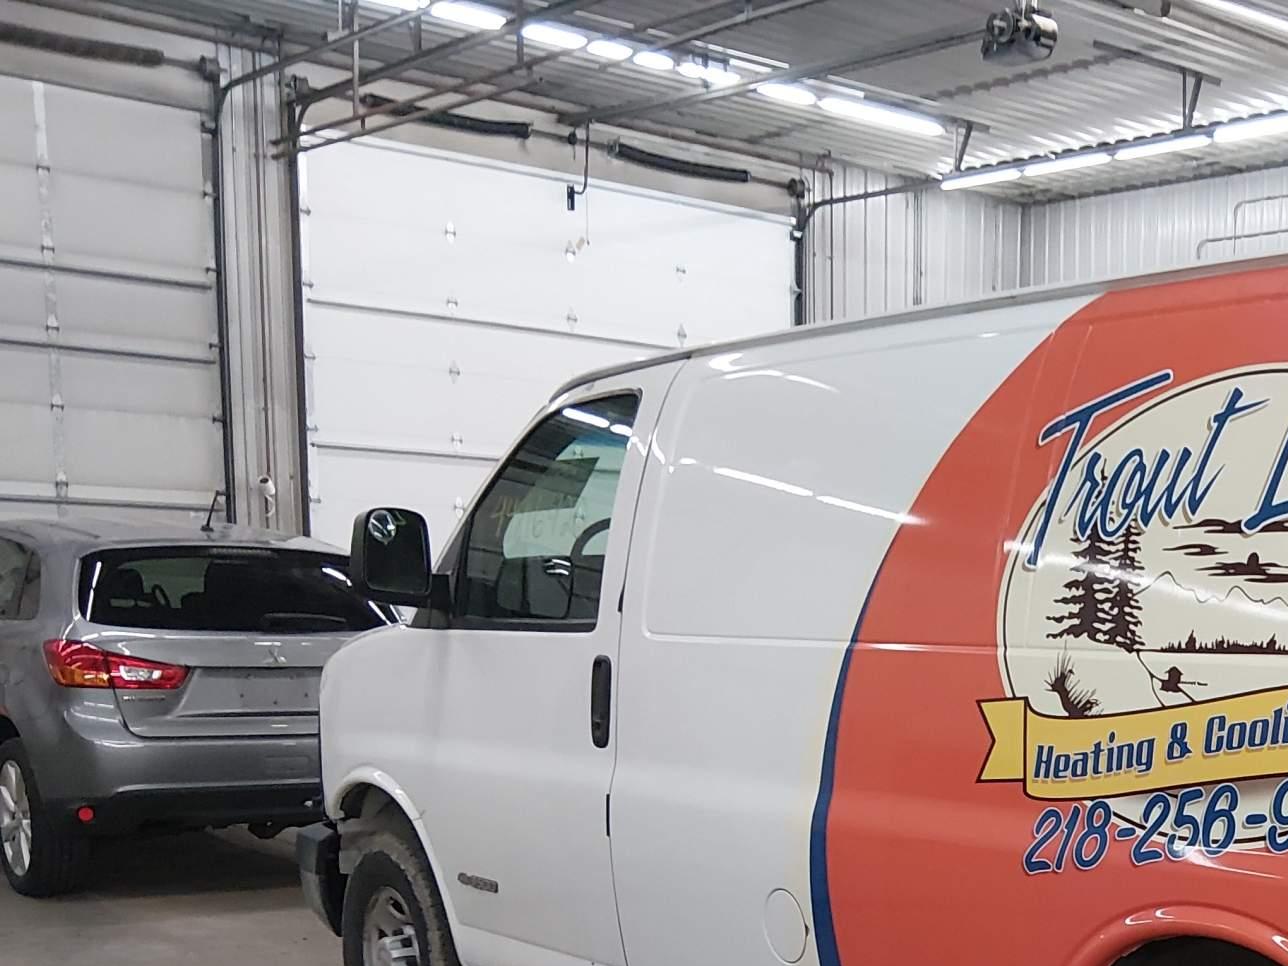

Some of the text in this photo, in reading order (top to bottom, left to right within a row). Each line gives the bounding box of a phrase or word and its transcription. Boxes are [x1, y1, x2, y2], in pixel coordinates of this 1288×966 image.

[1024, 370, 1271, 571] Trout
[1032, 731, 1155, 780] Heating
[1166, 722, 1190, 762] &
